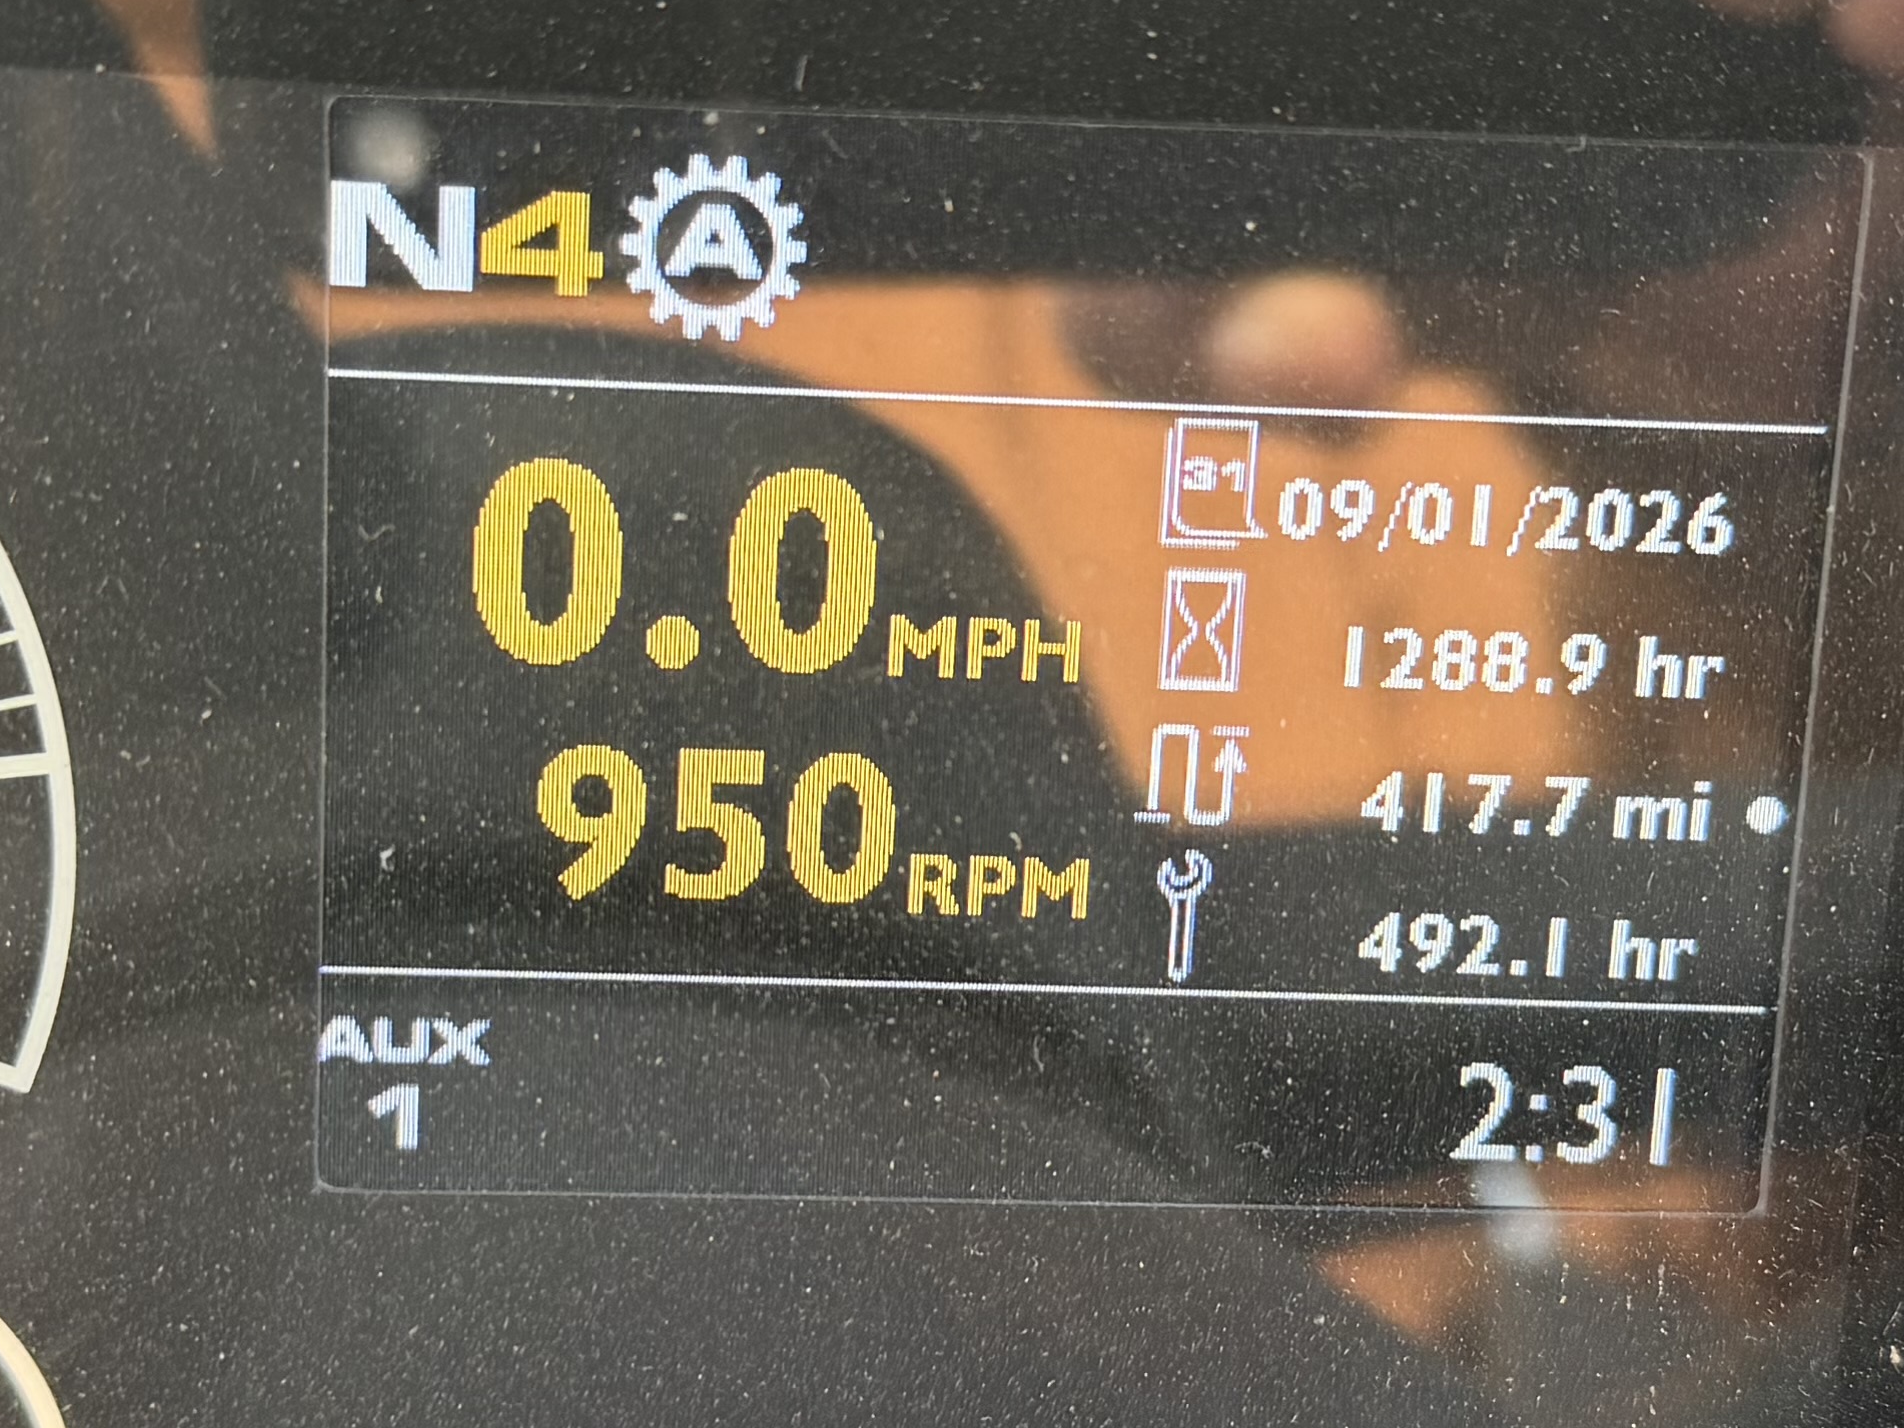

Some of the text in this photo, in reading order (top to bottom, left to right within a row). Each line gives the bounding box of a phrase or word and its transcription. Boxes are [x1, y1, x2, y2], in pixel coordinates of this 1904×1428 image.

[1277, 478, 1734, 556] 09/01/2026
[472, 457, 1082, 682] 0.0 MPH
[1343, 625, 1725, 699] 1288.9 hr
[537, 744, 1090, 919] 950 RPM
[1360, 771, 1712, 842] 417.7 mi
[1358, 912, 1698, 981] 492.1 hr
[317, 1015, 492, 1065] AUX
[367, 1083, 421, 1150] 1
[1450, 1062, 1678, 1167] 2:31
